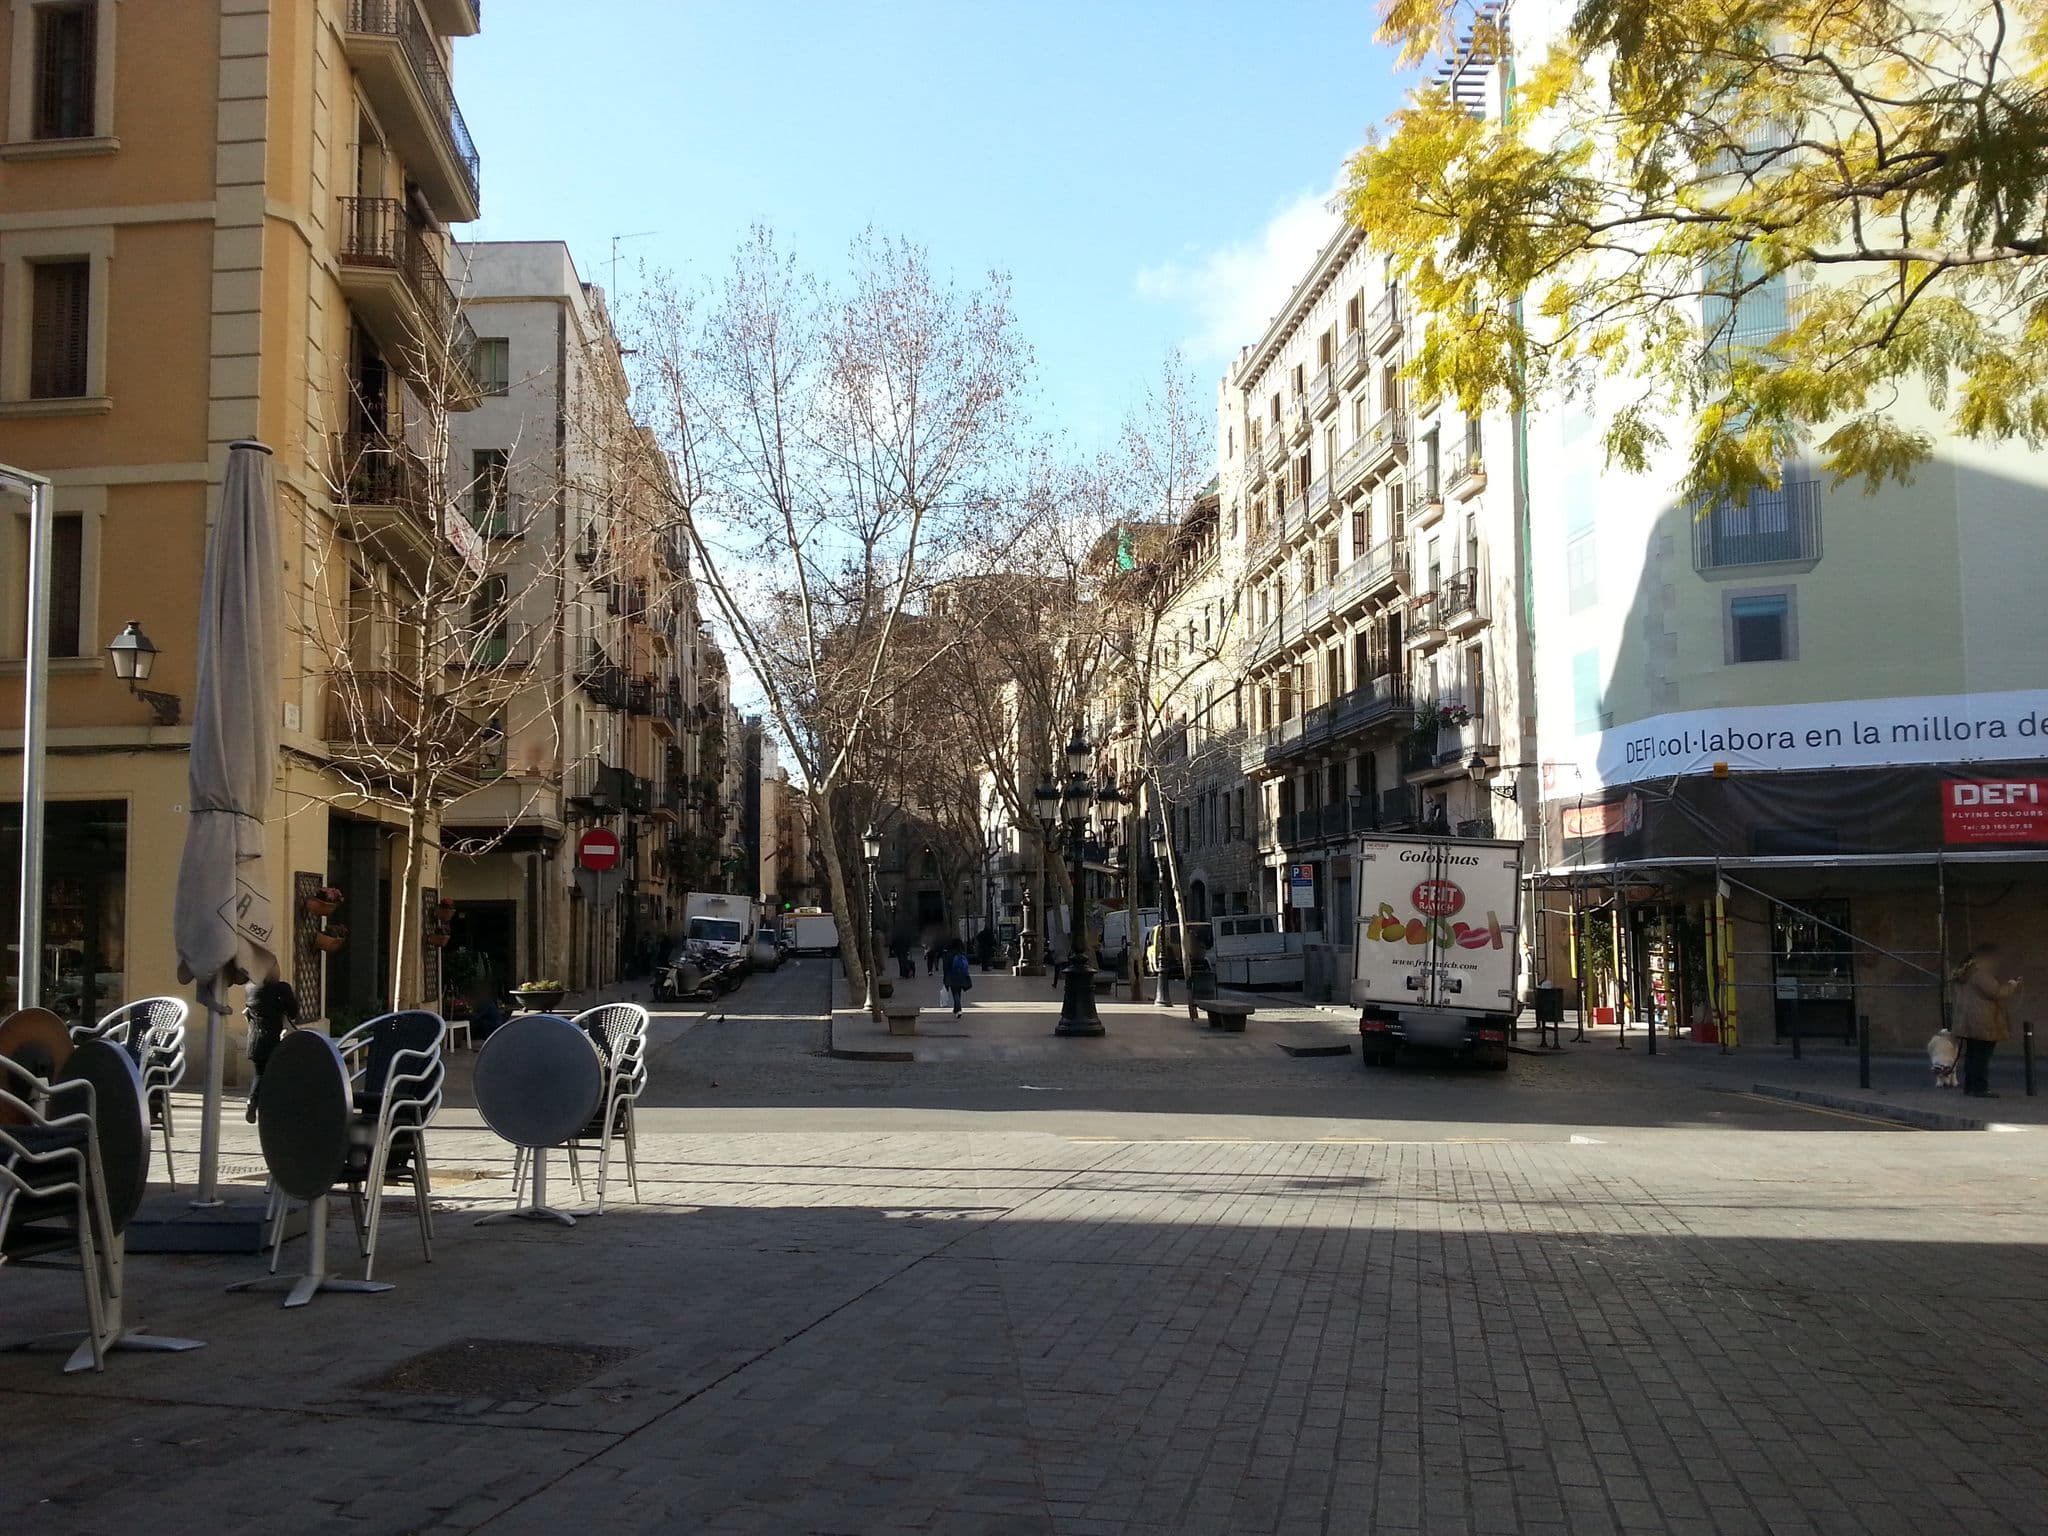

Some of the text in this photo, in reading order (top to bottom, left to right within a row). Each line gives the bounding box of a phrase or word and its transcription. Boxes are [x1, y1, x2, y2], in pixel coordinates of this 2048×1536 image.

[1626, 736, 1655, 763] DEFI
[1806, 727, 1841, 748] en
[1853, 720, 1880, 744] la
[1892, 715, 2007, 743] millora
[1954, 783, 2038, 805] DEFI
[1399, 849, 1480, 866] Golosinas
[1419, 885, 1458, 903] FRIT
[249, 922, 268, 937] 1957
